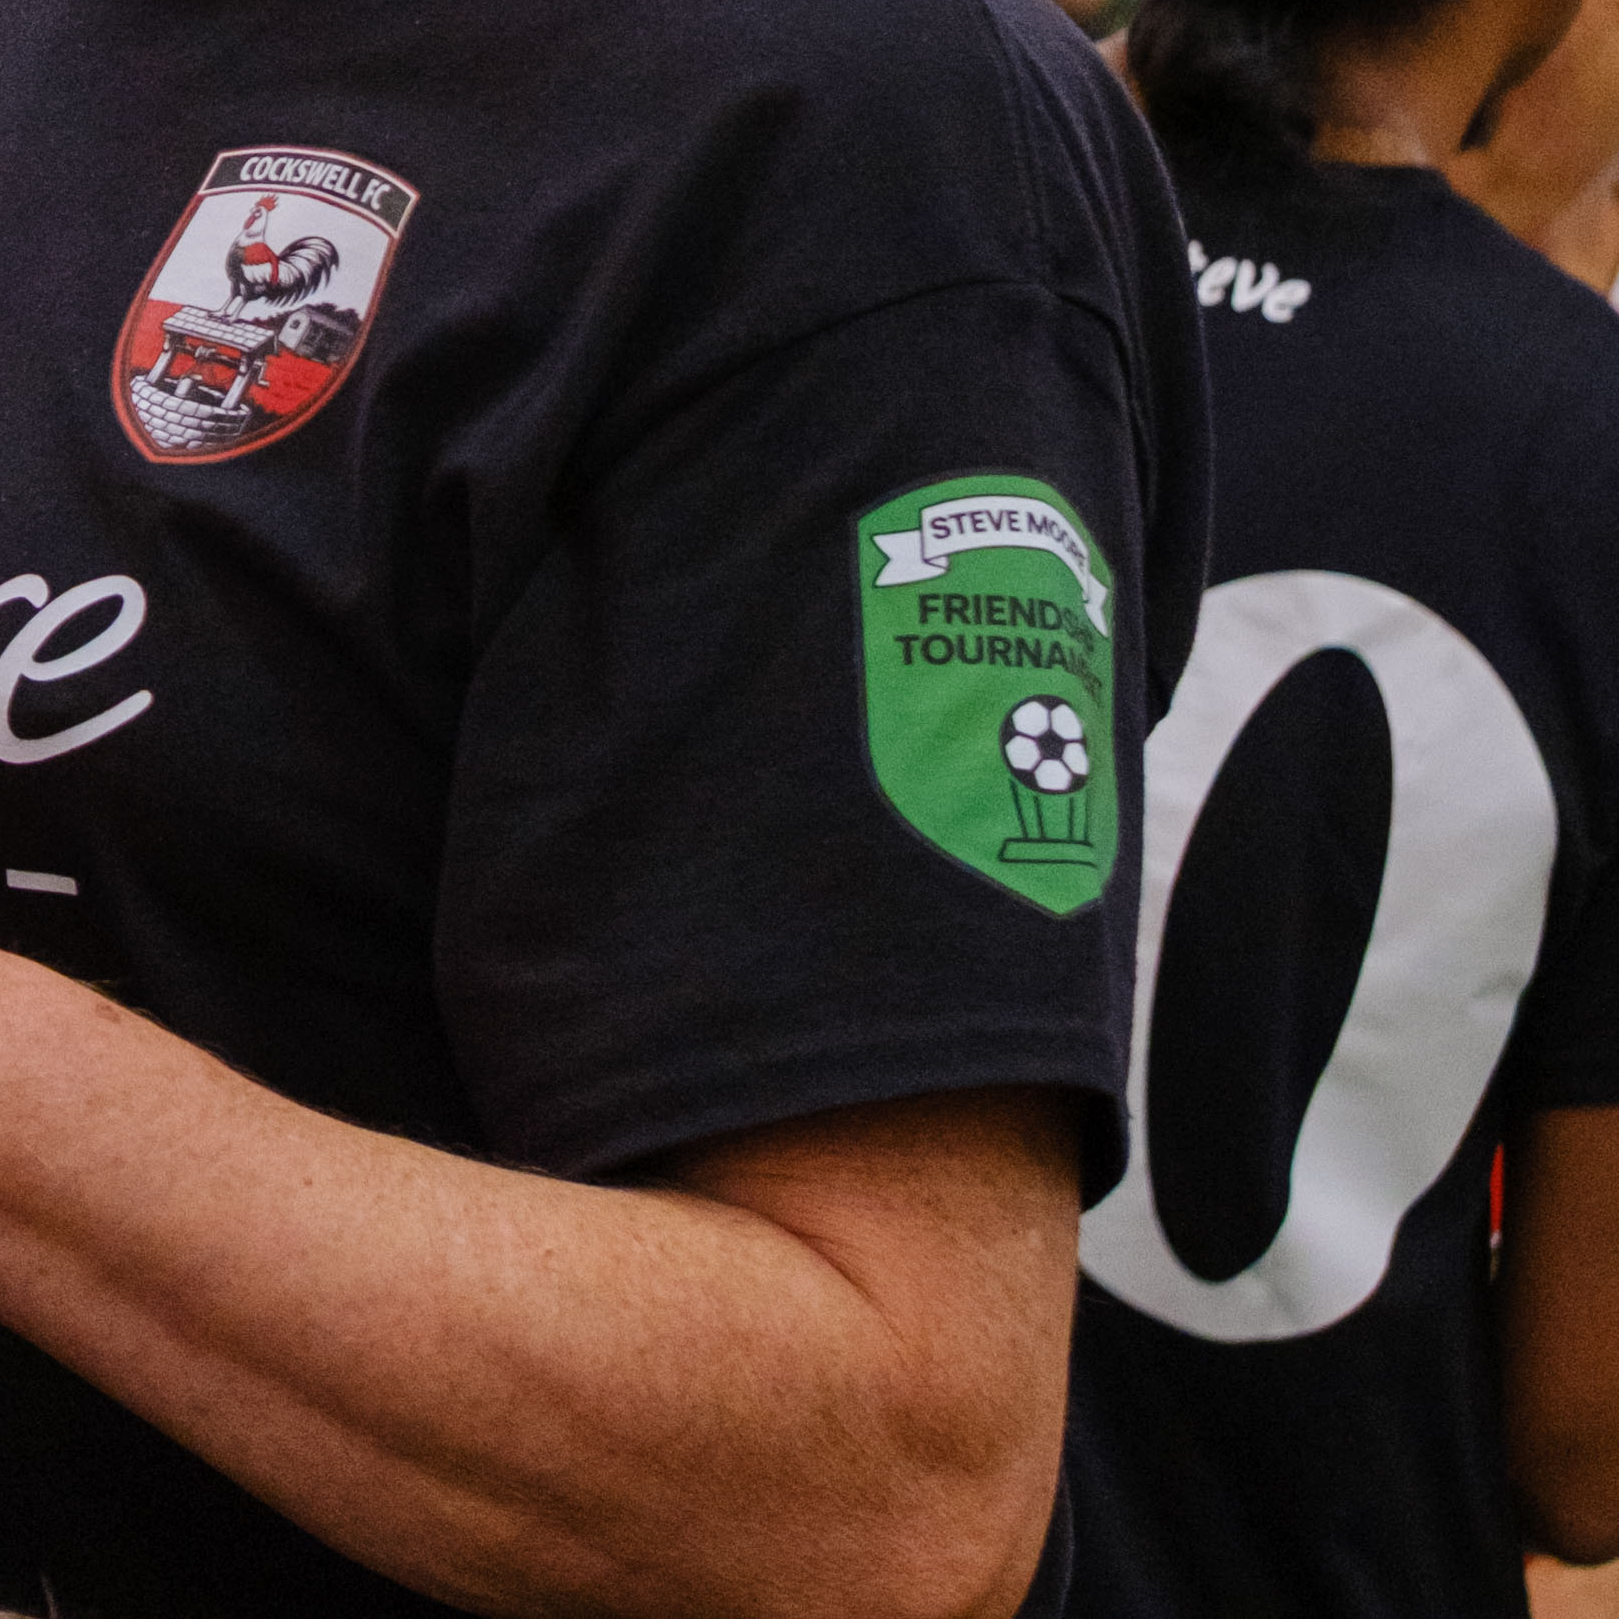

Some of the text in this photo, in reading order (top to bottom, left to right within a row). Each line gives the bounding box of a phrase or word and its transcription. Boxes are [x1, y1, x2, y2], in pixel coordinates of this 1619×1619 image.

[240, 155, 391, 211] COCKSWELL FC
[929, 508, 1022, 540] STEVE
